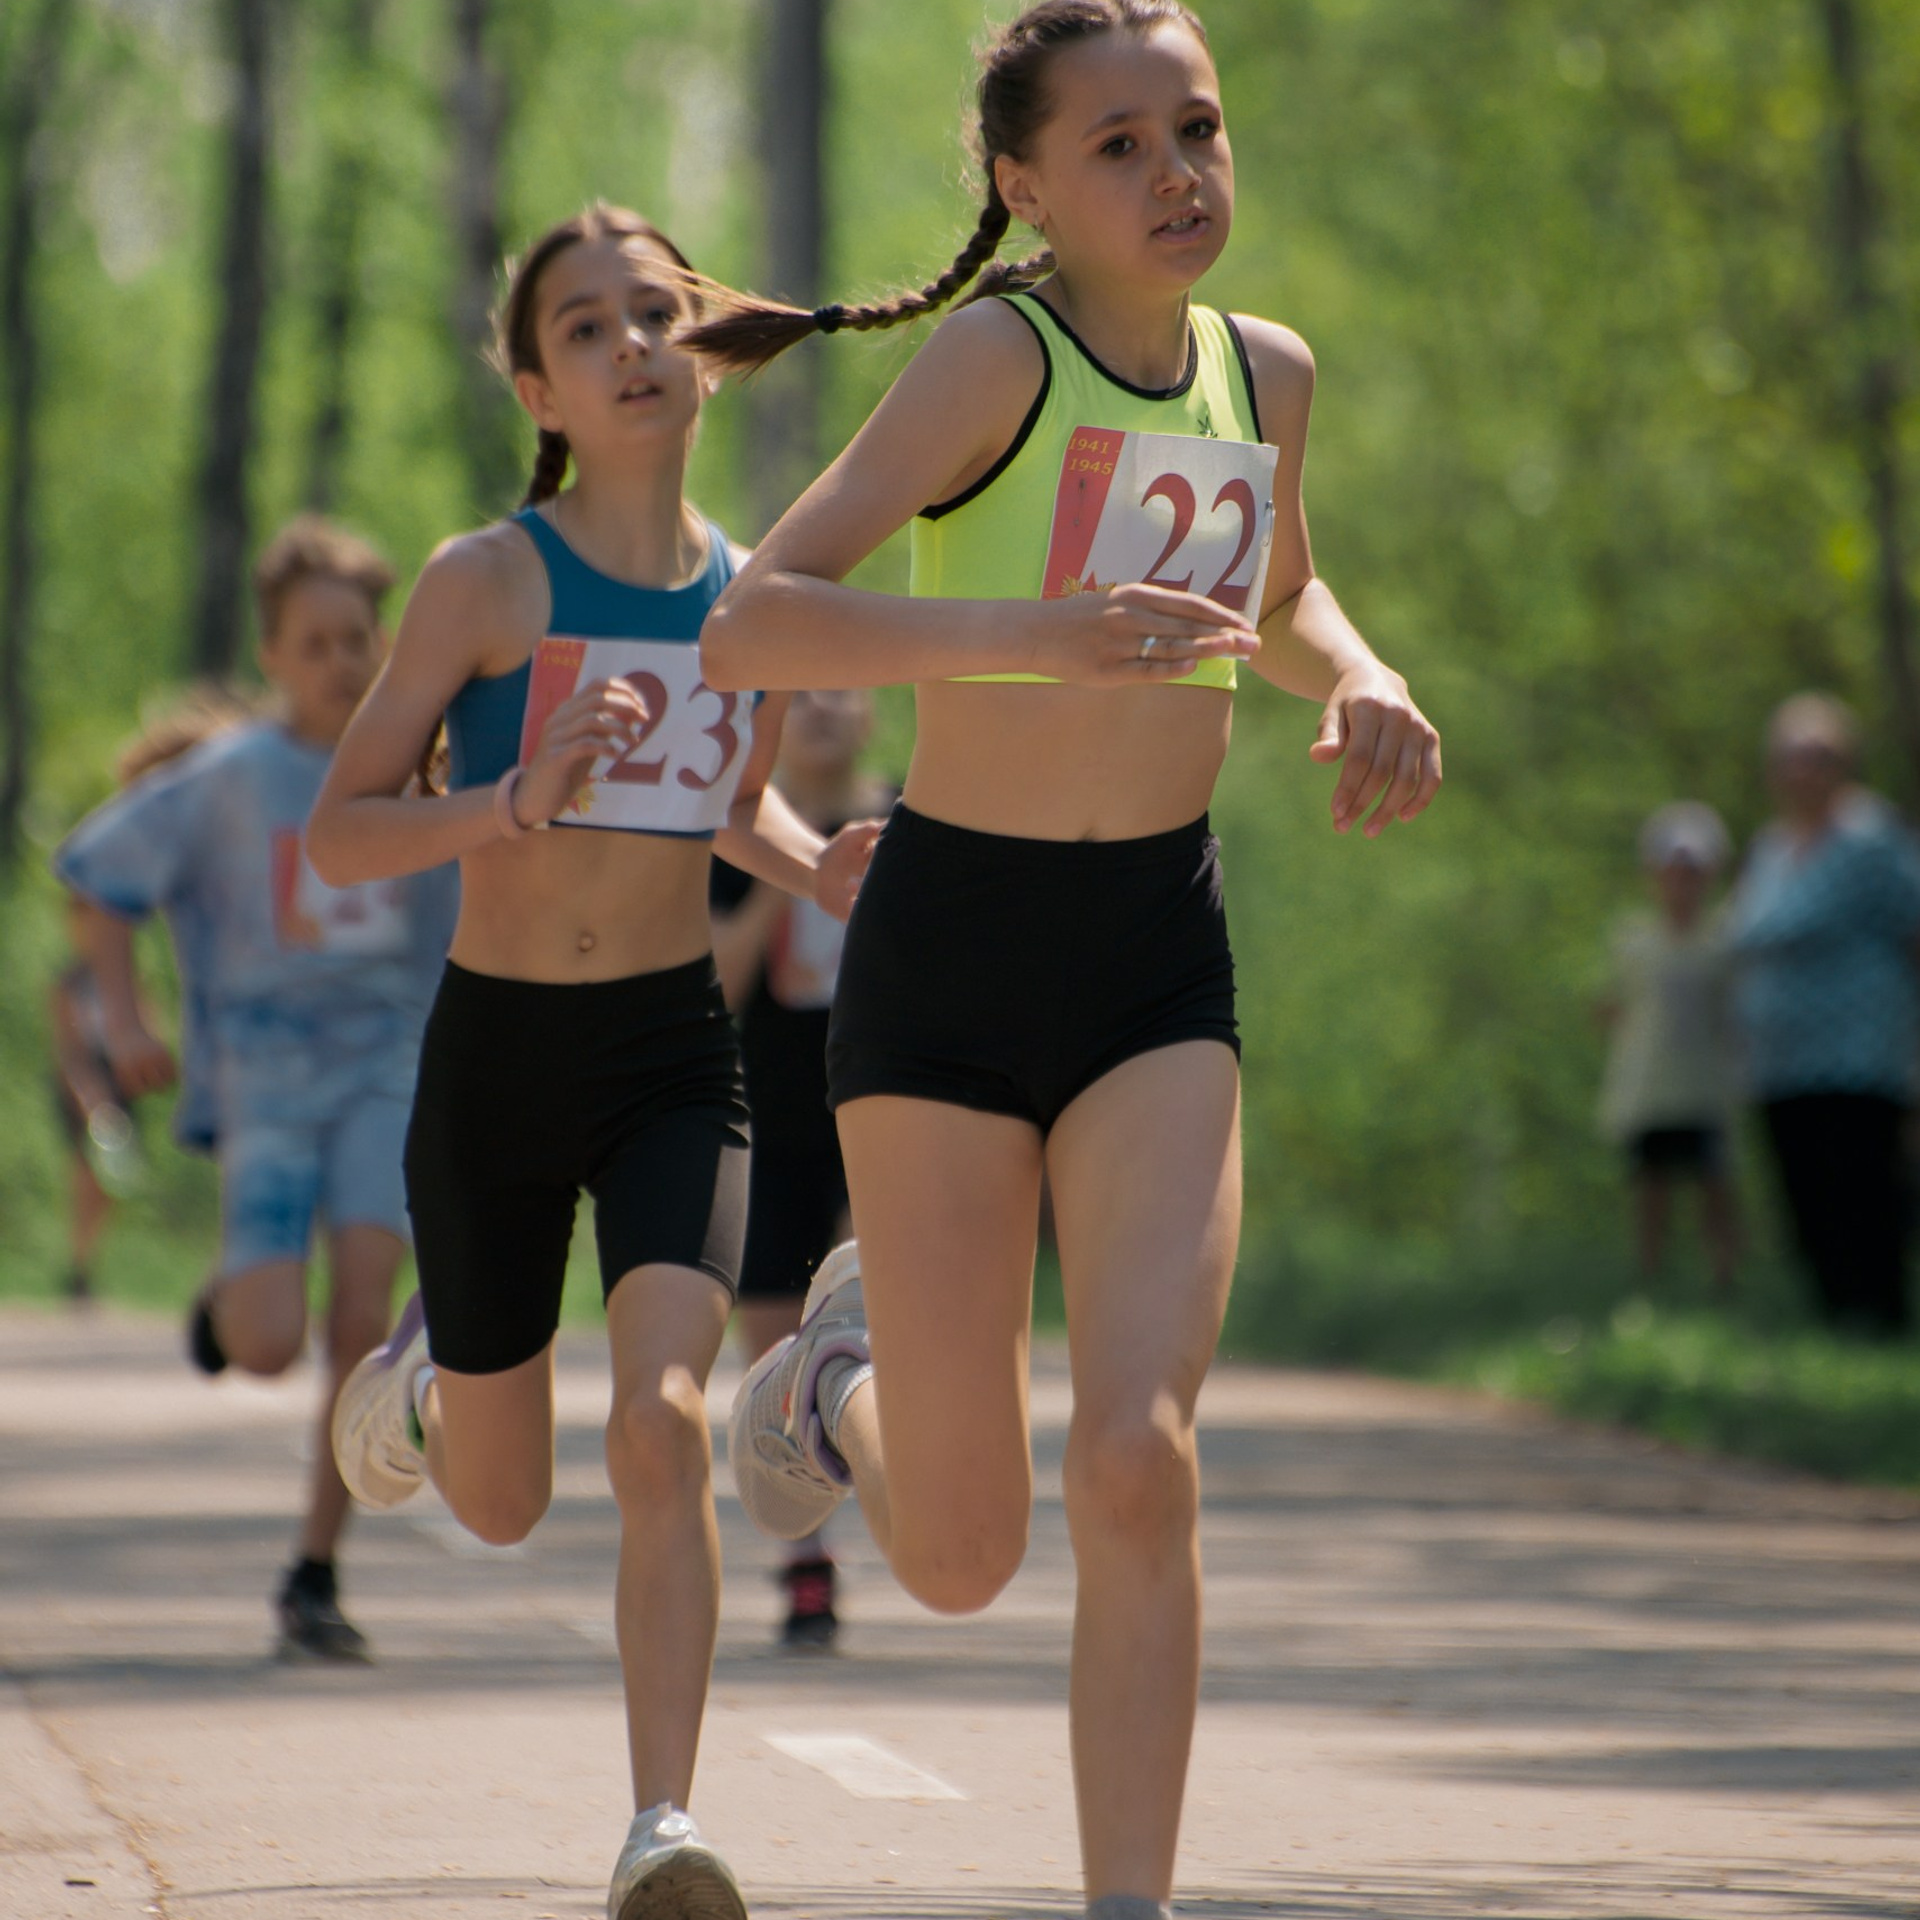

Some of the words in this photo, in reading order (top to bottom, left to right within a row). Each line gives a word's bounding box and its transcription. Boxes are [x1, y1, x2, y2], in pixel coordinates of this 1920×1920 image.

[1068, 438, 1109, 455] 1941
[1069, 459, 1114, 475] 1945
[1140, 472, 1257, 612] 22
[603, 671, 738, 792] 23
